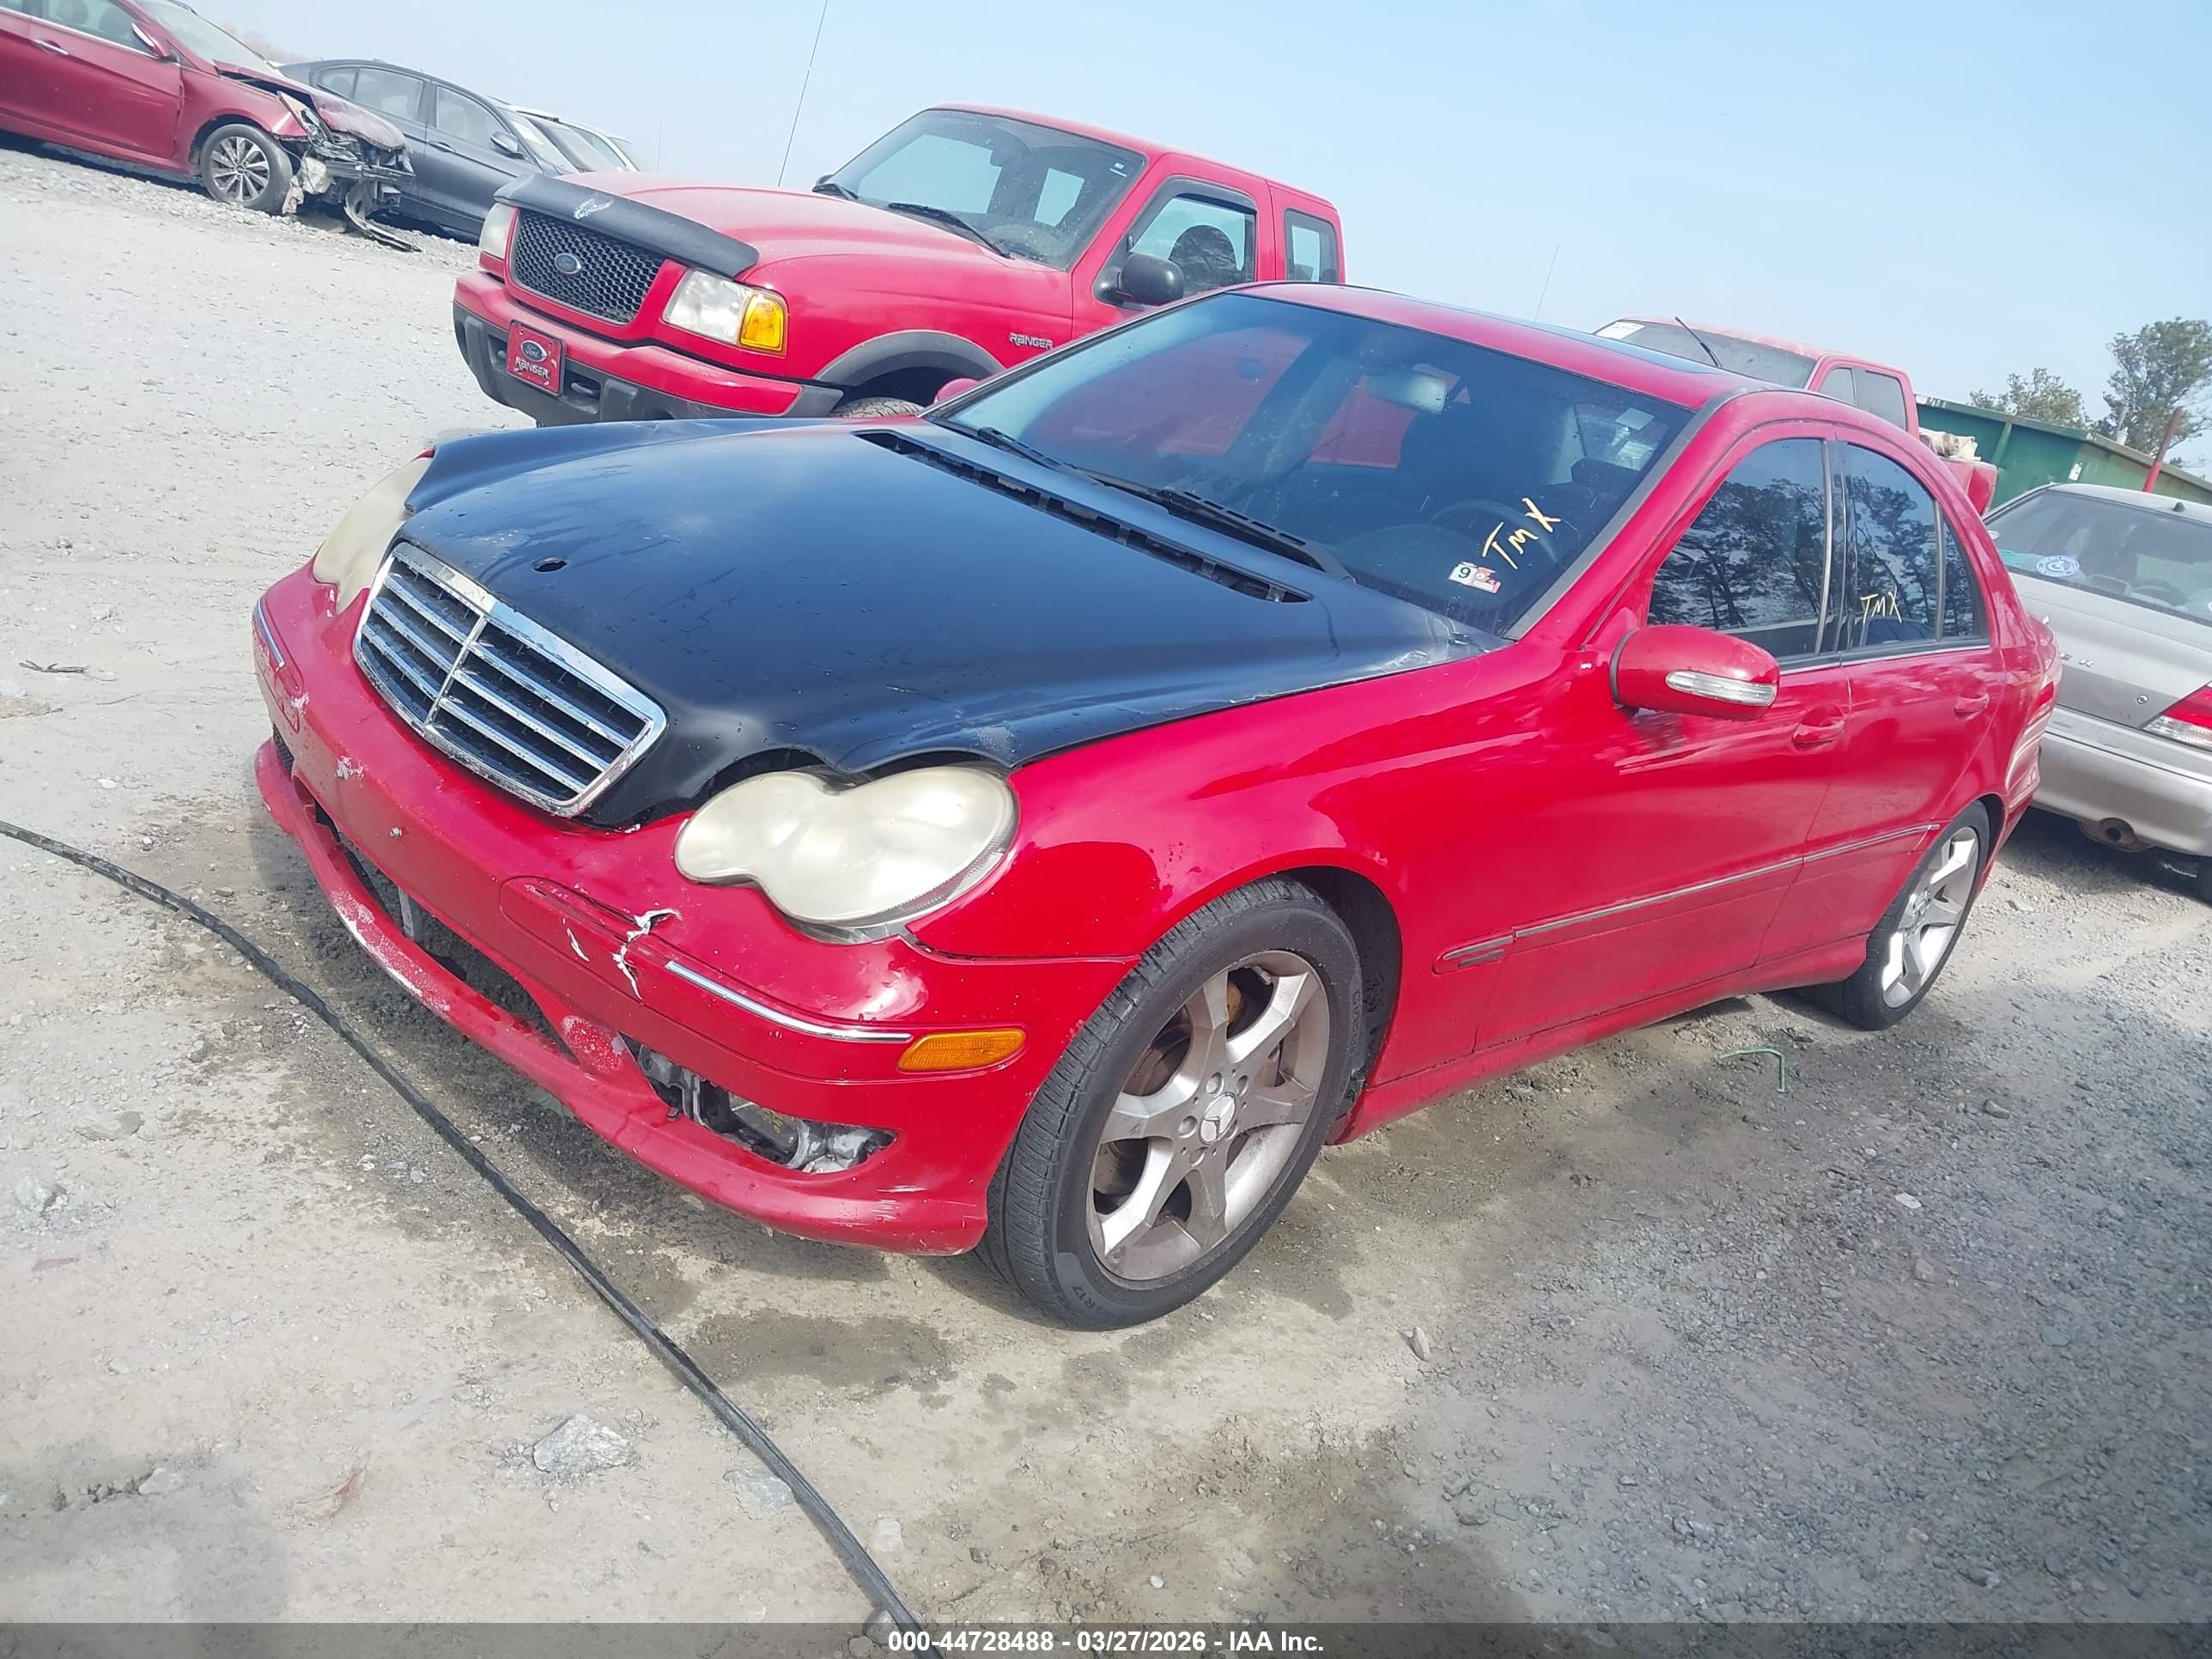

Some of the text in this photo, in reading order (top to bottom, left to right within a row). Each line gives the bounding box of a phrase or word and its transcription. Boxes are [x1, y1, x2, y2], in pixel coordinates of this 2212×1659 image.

[1010, 331, 1053, 349] RANGER
[515, 356, 550, 379] RANGER
[1458, 567, 1472, 579] 9
[1859, 585, 1903, 626] TMX
